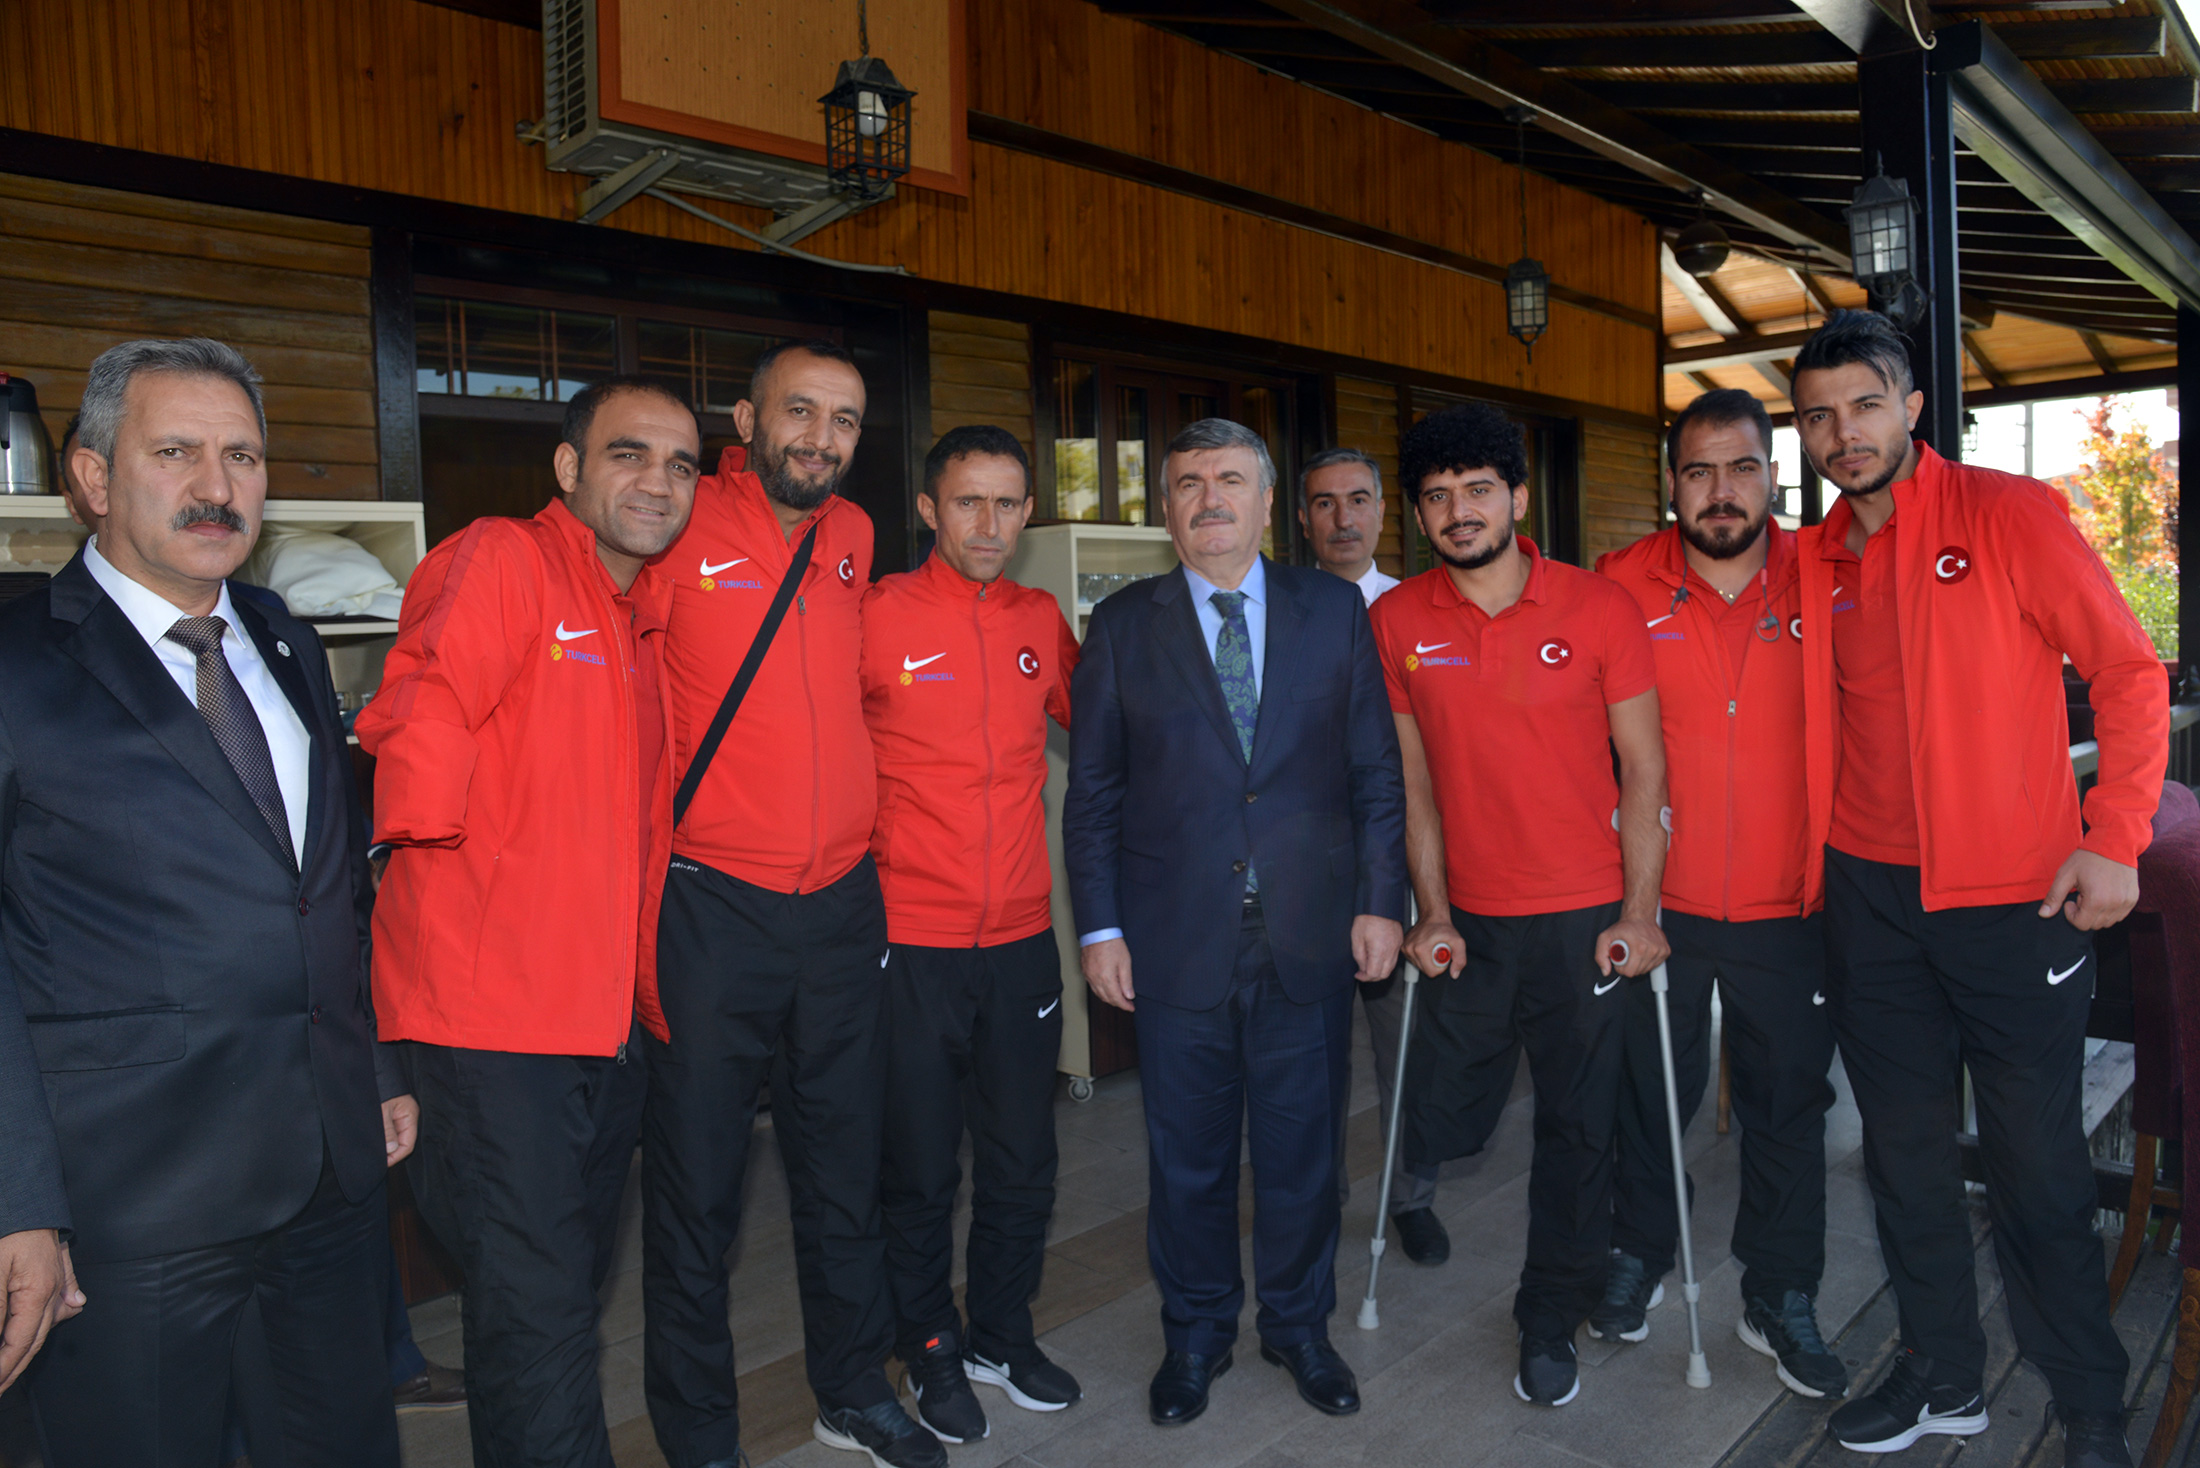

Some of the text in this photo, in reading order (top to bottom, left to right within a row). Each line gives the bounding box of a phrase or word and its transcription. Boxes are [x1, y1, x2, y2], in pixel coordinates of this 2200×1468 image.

[717, 580, 763, 589] TURKCELL
[565, 649, 607, 666] TURKCELL
[1421, 656, 1471, 667] TURKCELL
[915, 672, 956, 682] TURKCELL
